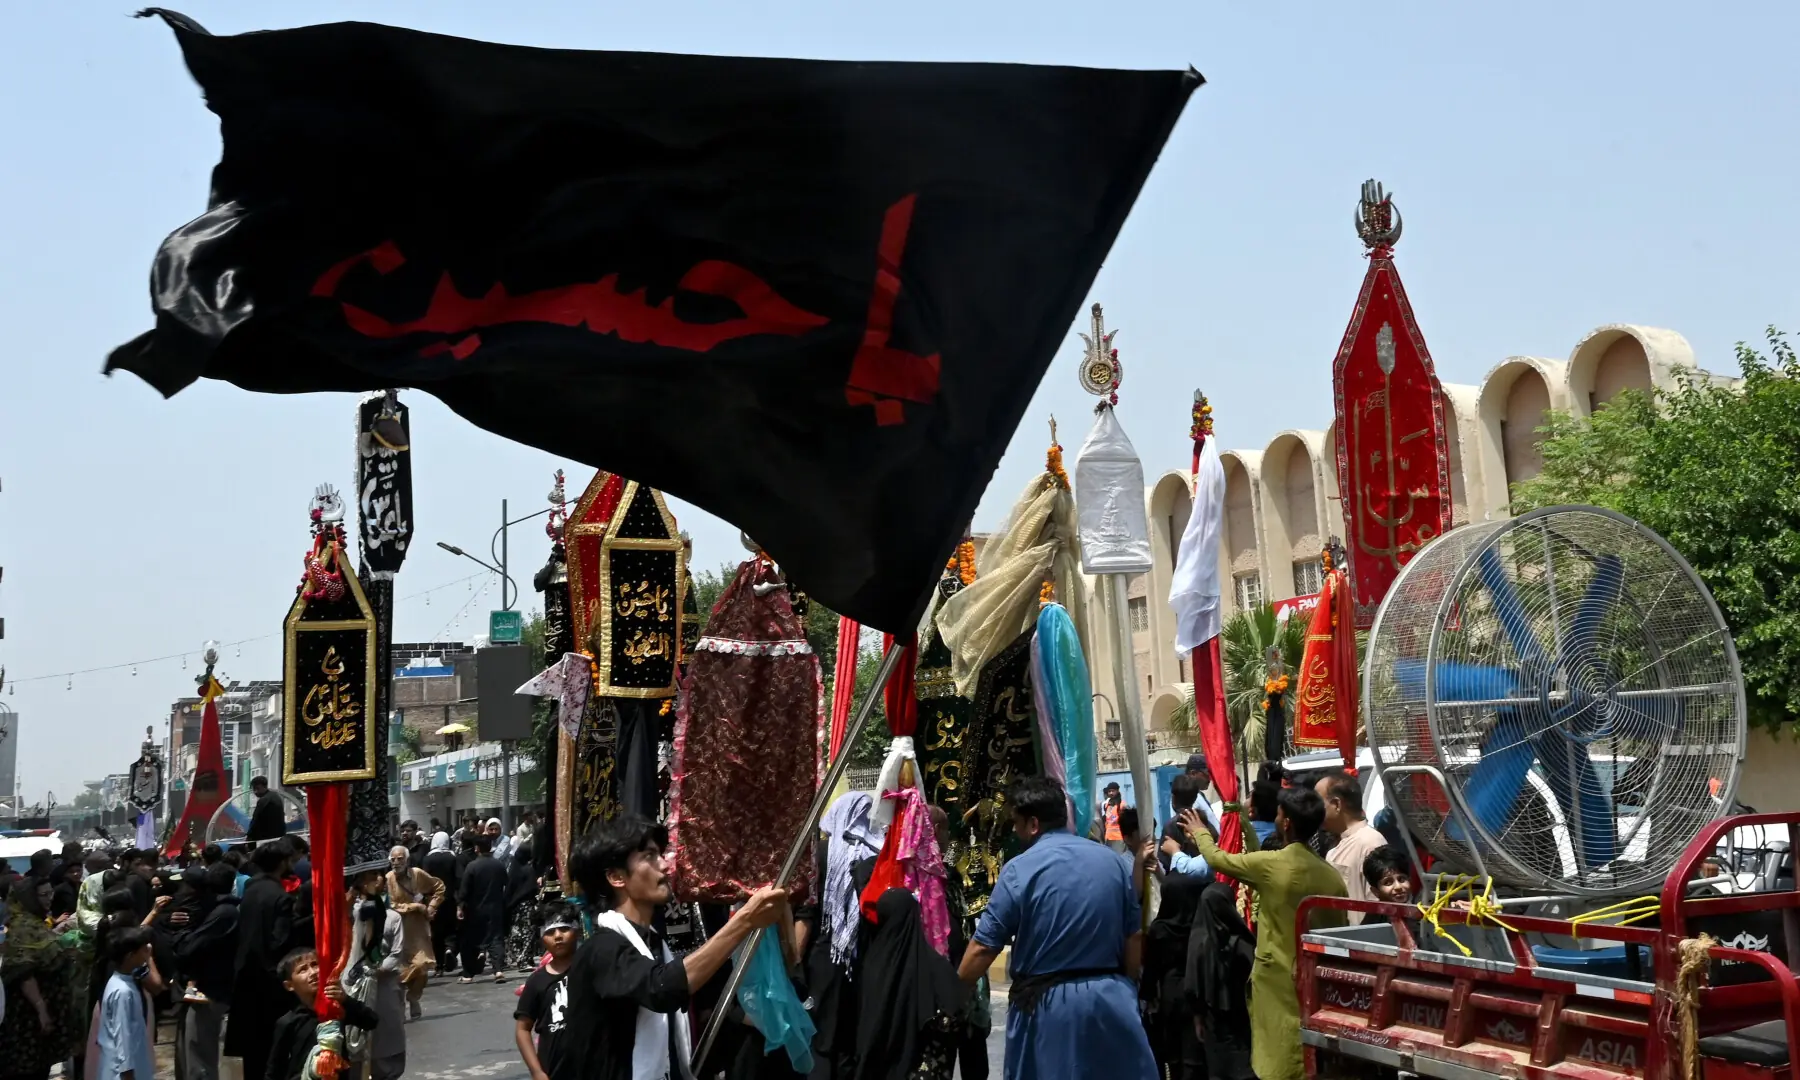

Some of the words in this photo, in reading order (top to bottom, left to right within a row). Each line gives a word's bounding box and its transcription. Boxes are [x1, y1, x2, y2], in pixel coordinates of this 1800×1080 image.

[845, 193, 941, 426] یا
[1402, 1000, 1444, 1028] NEW
[1578, 1037, 1637, 1069] ASIA
